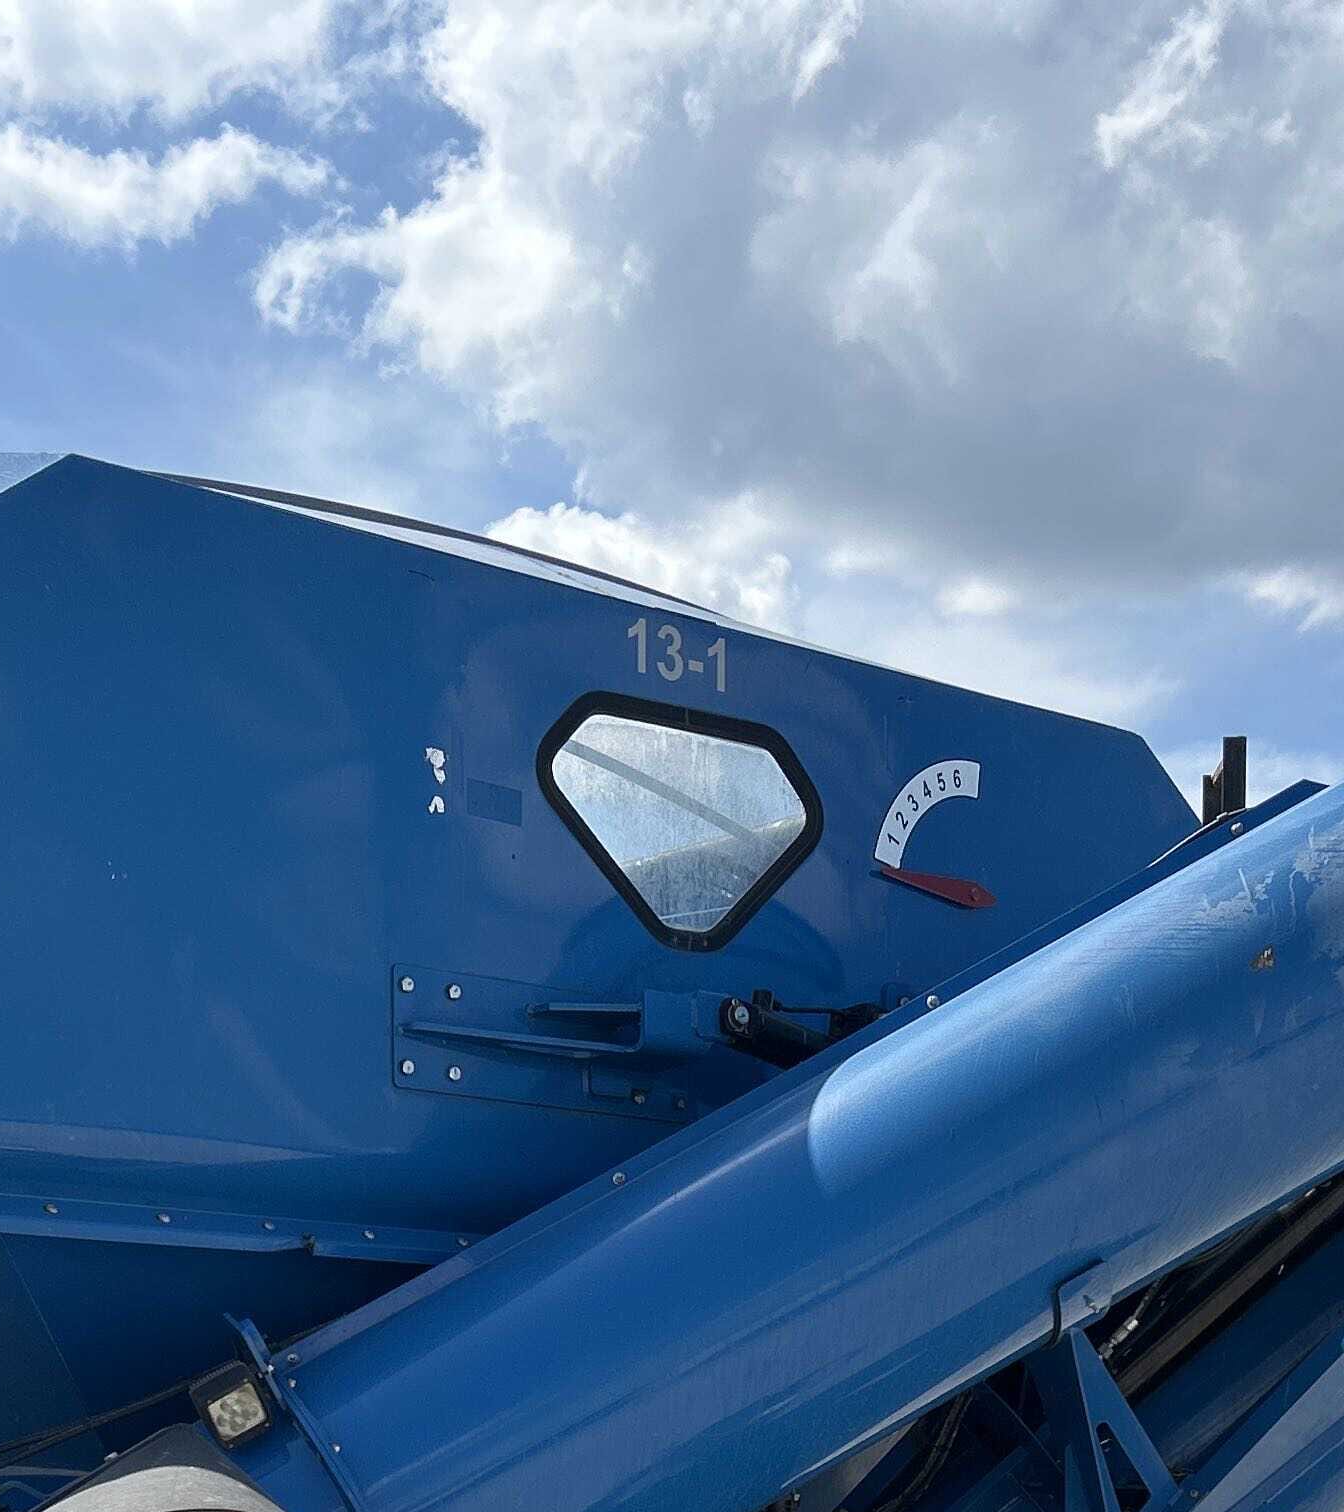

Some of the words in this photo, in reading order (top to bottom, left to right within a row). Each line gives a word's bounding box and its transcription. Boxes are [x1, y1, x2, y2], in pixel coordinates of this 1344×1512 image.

[627, 618, 726, 693] 13-1
[887, 832, 900, 846] 1
[895, 811, 908, 830] 2
[907, 794, 919, 812] 3
[922, 780, 932, 798] 4
[937, 772, 946, 791] 5
[953, 769, 961, 789] 6
